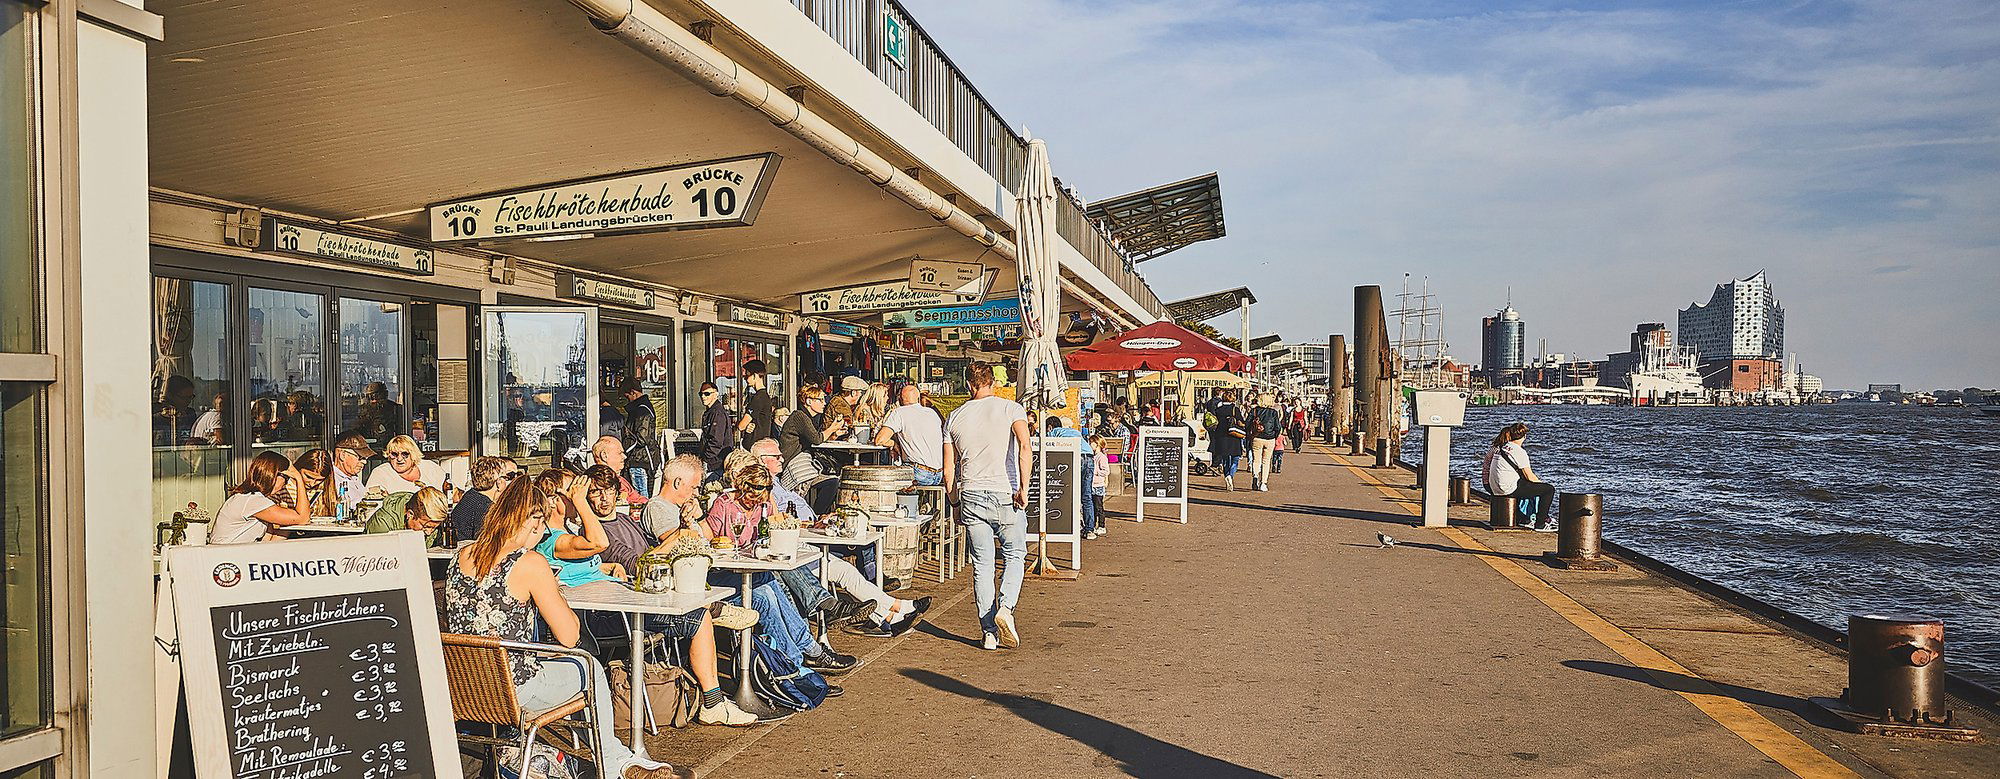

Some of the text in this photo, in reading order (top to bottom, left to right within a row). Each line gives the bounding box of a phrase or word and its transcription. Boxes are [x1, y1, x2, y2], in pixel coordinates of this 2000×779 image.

[682, 167, 744, 190] BRÜCKE
[442, 203, 482, 219] BRÜCKE
[494, 182, 674, 223] Fischbrötchenbude
[691, 186, 738, 218] 10
[448, 216, 477, 237] 10
[494, 212, 674, 235] St. Pauli Landungsbrücken
[283, 235, 299, 250] 10
[416, 259, 429, 272] 10
[921, 272, 934, 282] 10
[812, 299, 829, 311] 10
[914, 305, 1019, 323] Seemannsshop
[248, 559, 340, 582] ERDINGER
[341, 556, 400, 577] Weißbier
[230, 597, 385, 635] Unsere Fischbrötchen:
[229, 631, 323, 659] Mit Zwiebeln:
[226, 656, 300, 688] Bismarck
[231, 680, 300, 709] Seelachs
[234, 696, 321, 728] kräutermatjes
[234, 722, 312, 750] Brathering
[240, 736, 346, 772] Mit Remoulade:
